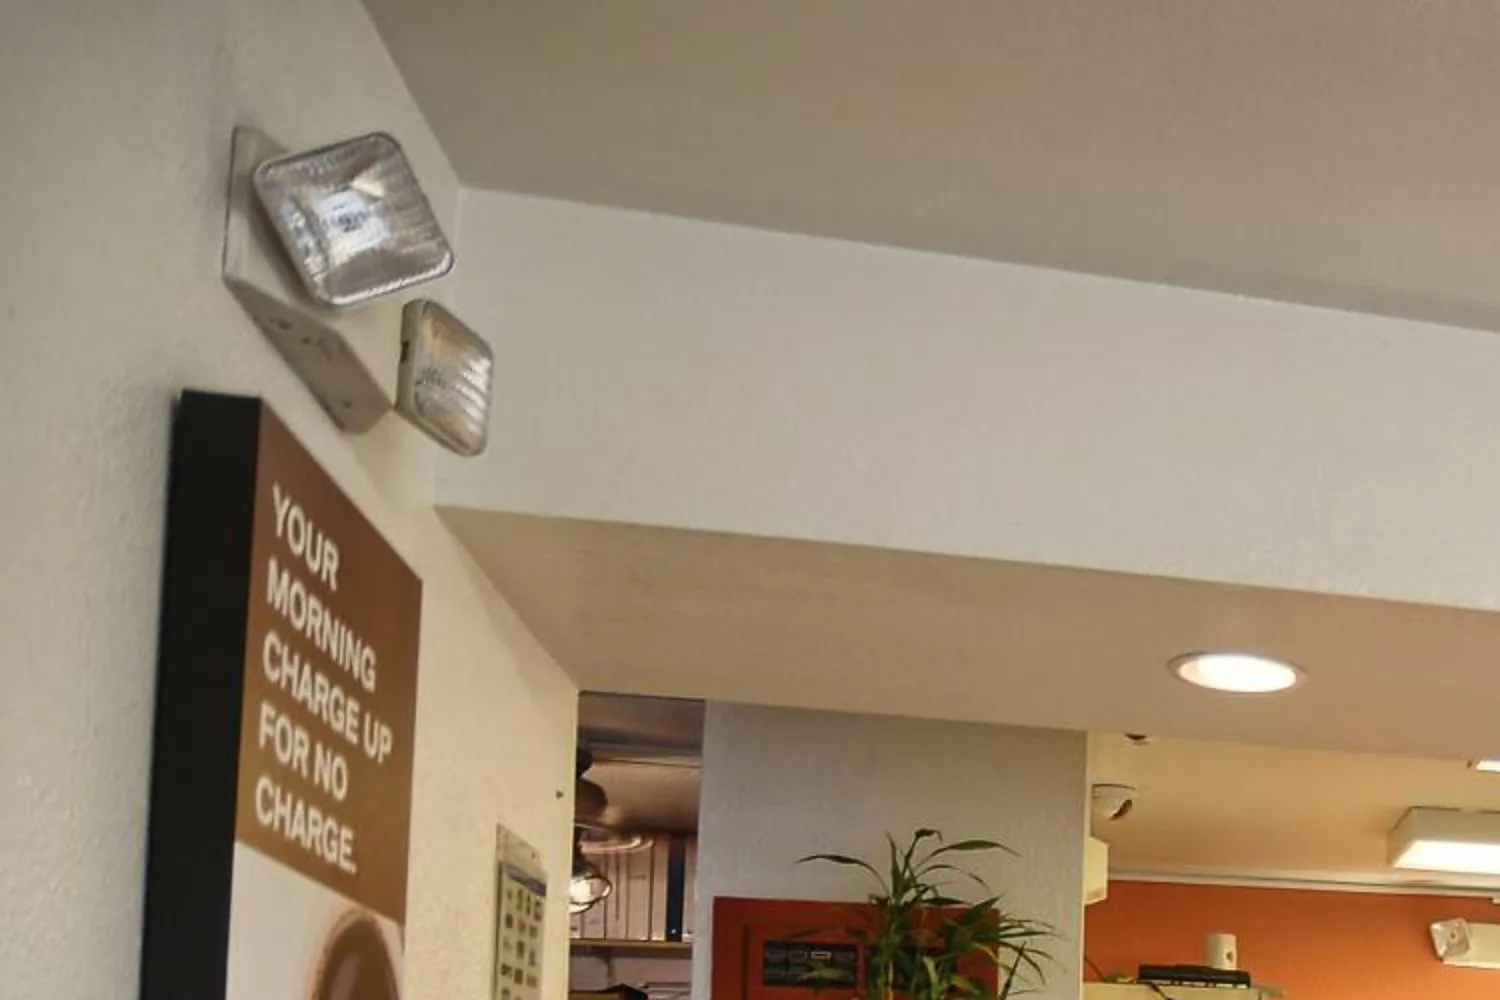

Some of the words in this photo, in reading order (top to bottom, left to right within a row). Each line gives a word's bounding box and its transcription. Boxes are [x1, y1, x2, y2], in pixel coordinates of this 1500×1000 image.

[271, 484, 340, 590] YOUR
[267, 558, 377, 692] MORNING
[262, 630, 359, 745] CHARGE
[363, 712, 392, 764] UP
[259, 703, 309, 778] FOR
[313, 743, 348, 801] NO
[255, 776, 358, 874] CHARGE.
